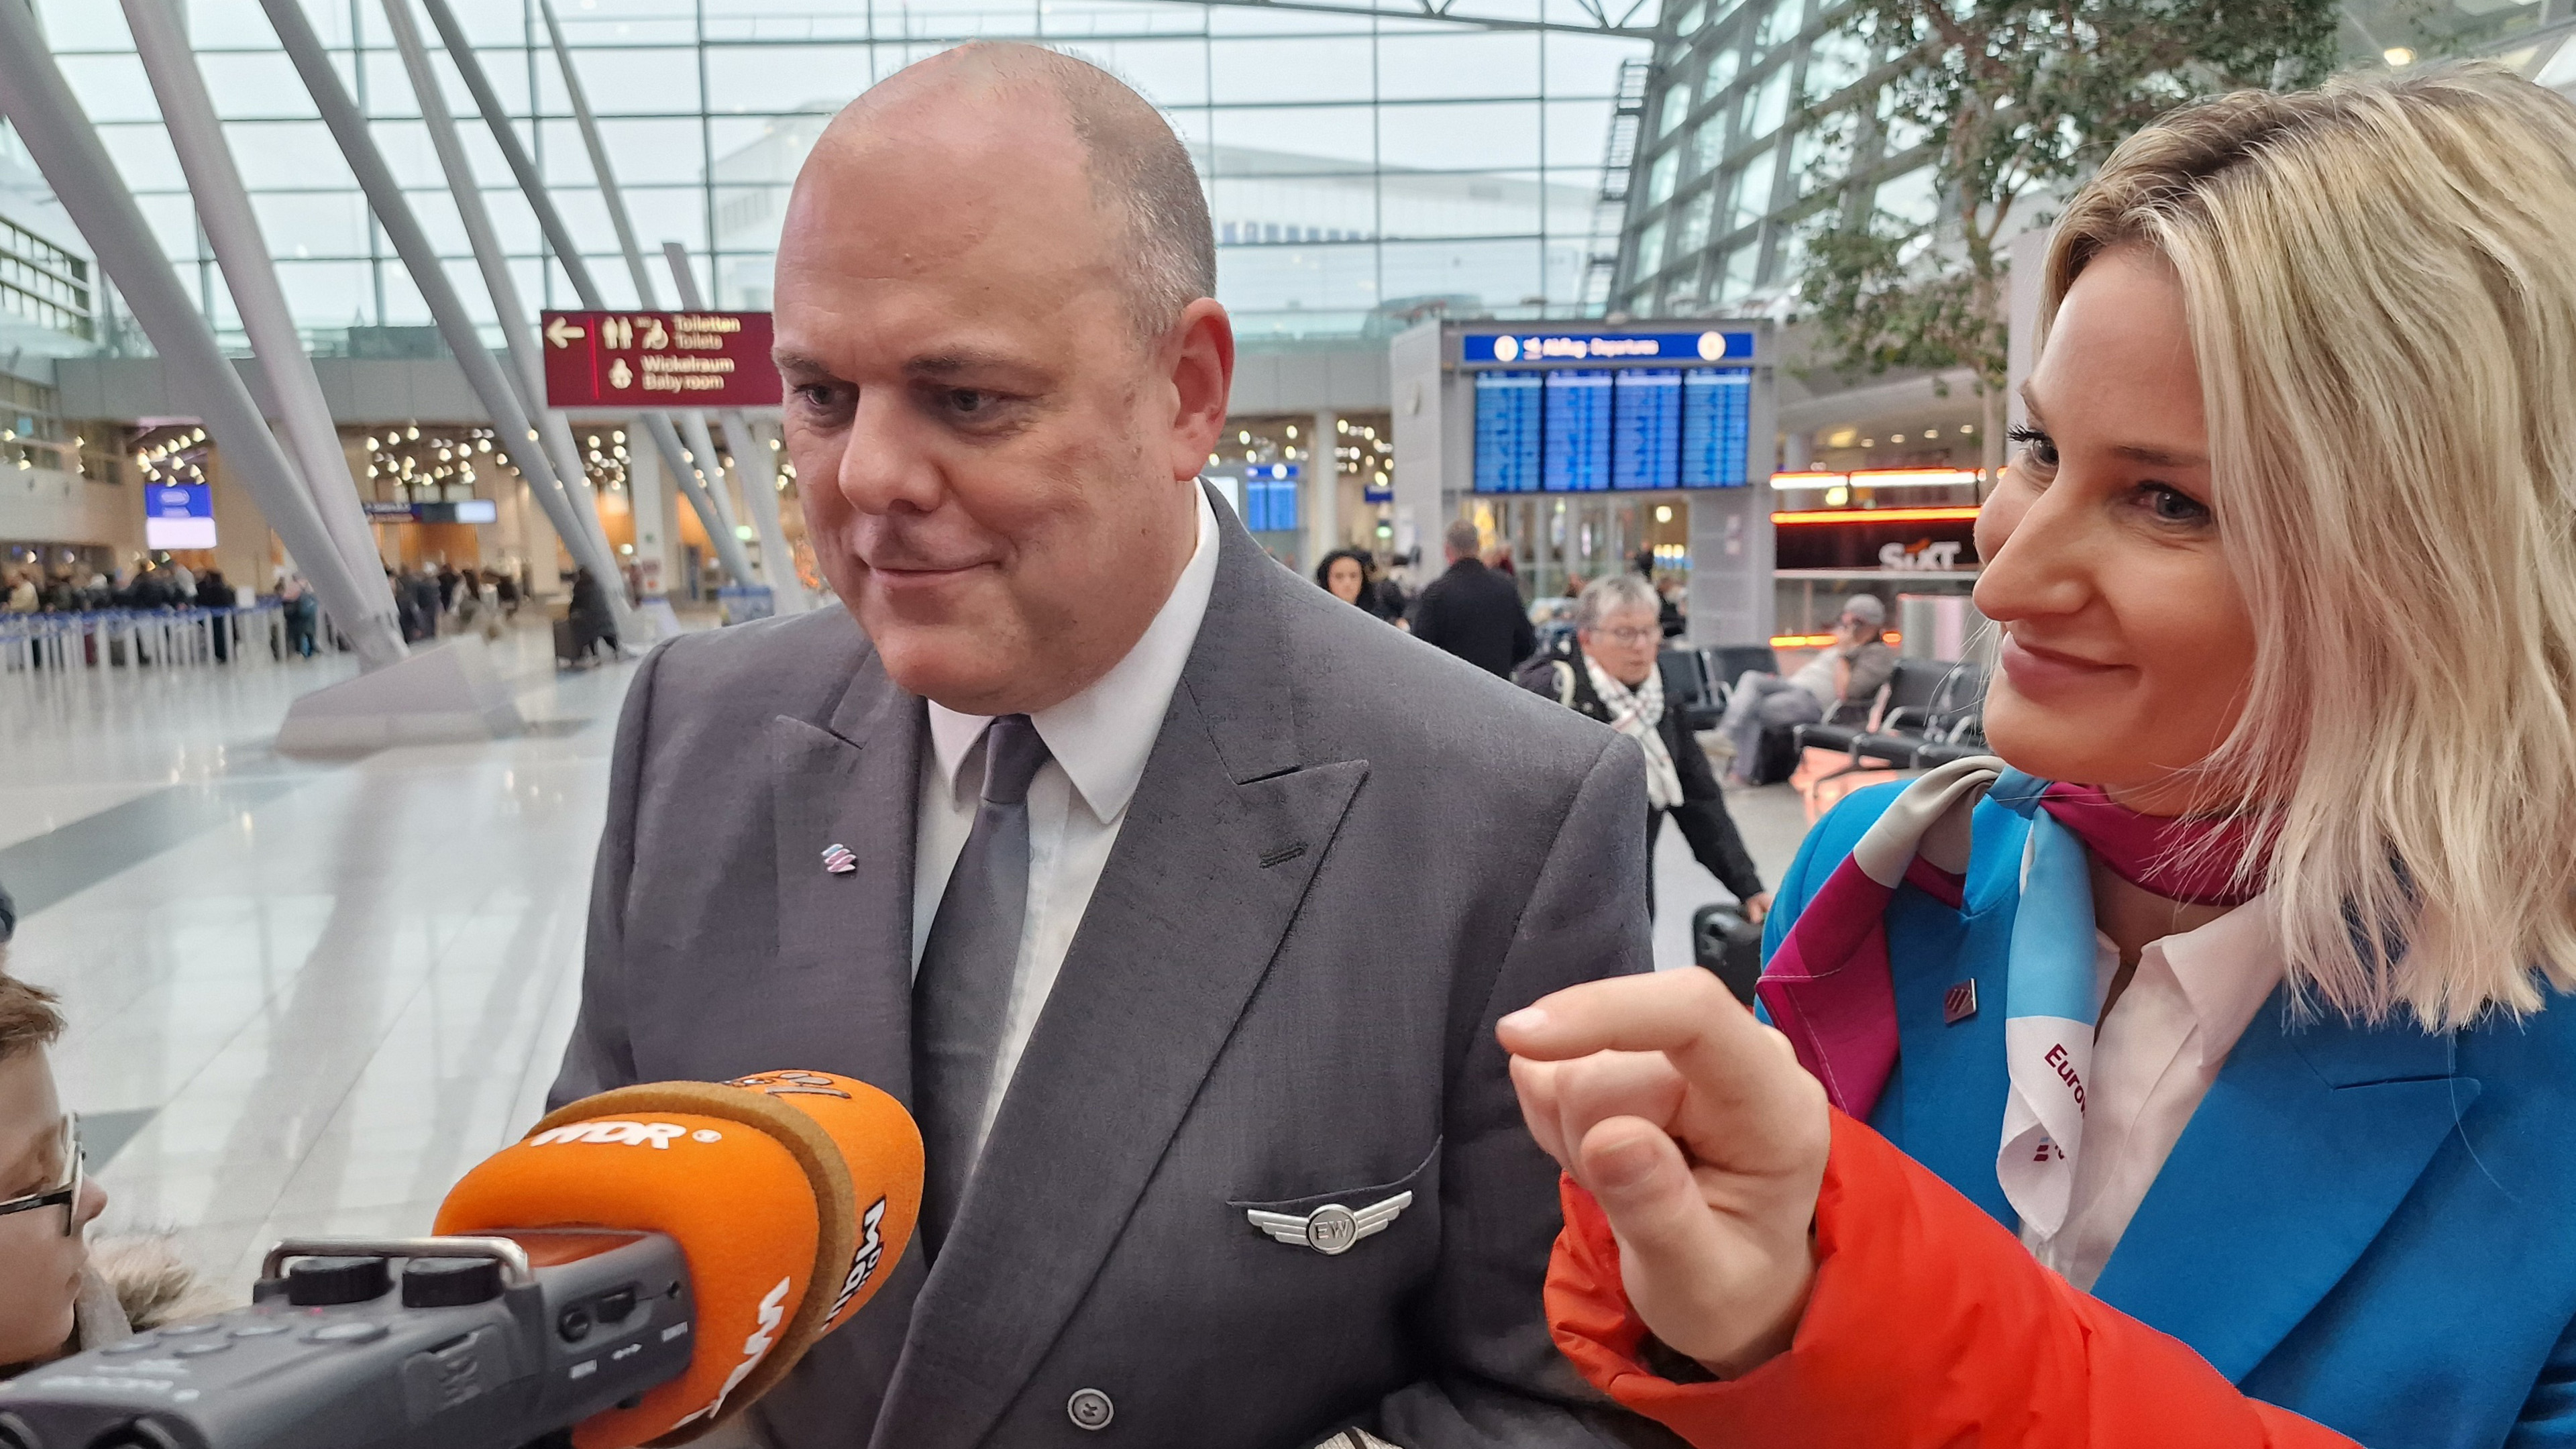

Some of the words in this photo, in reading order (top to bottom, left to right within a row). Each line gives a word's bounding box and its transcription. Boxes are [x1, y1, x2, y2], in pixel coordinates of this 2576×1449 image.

[674, 314, 741, 333] Toiletten
[640, 354, 735, 373] Wickelraum
[642, 372, 682, 392] Baby
[683, 374, 724, 390] room
[529, 1120, 687, 1150] WDR
[1314, 1219, 1350, 1240] EW
